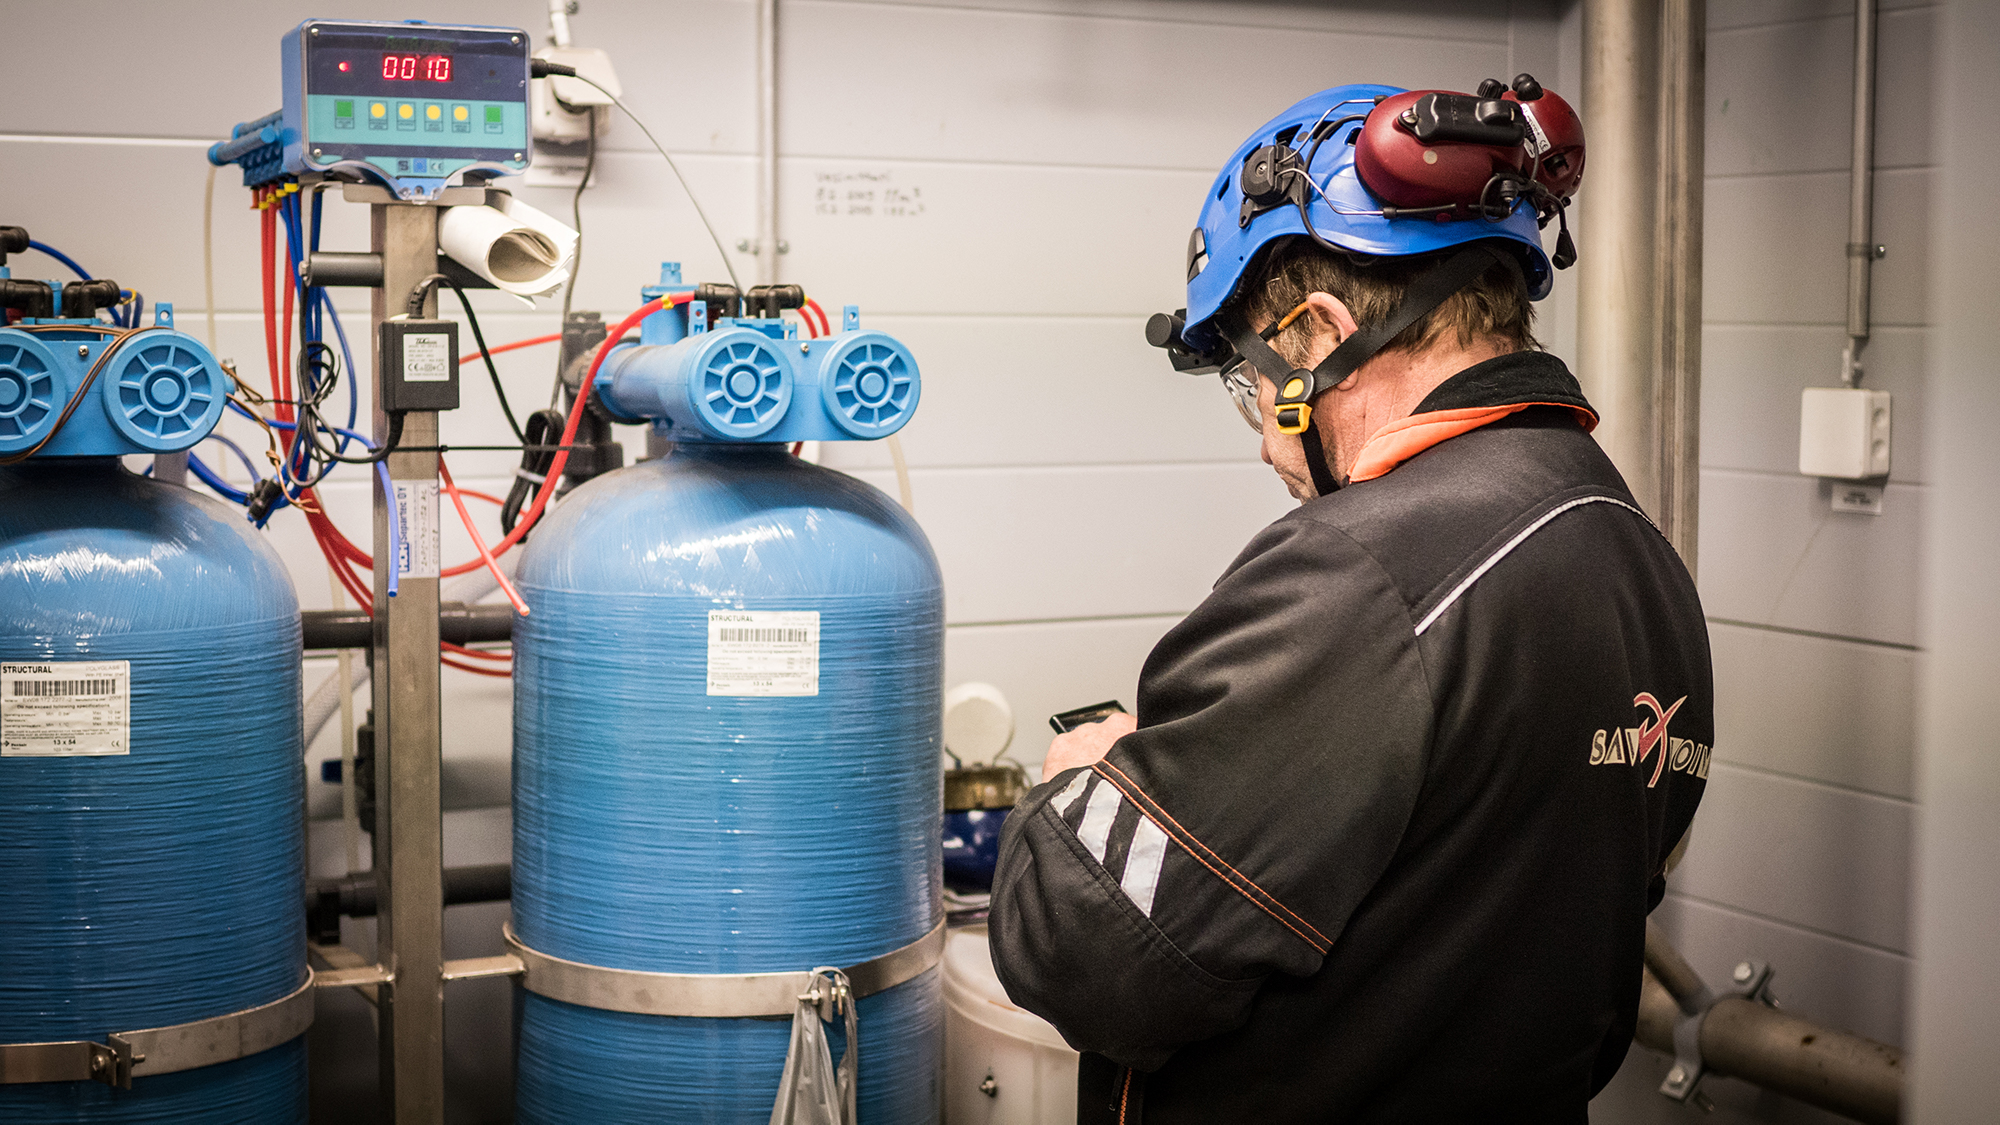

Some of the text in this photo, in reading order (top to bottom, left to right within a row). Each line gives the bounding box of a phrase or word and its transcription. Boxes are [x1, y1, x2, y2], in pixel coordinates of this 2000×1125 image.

[383, 56, 450, 80] 0010
[399, 502, 408, 542] Separtec
[711, 614, 754, 622] STRUCTURAL
[2, 665, 52, 673] STRUCTURAL
